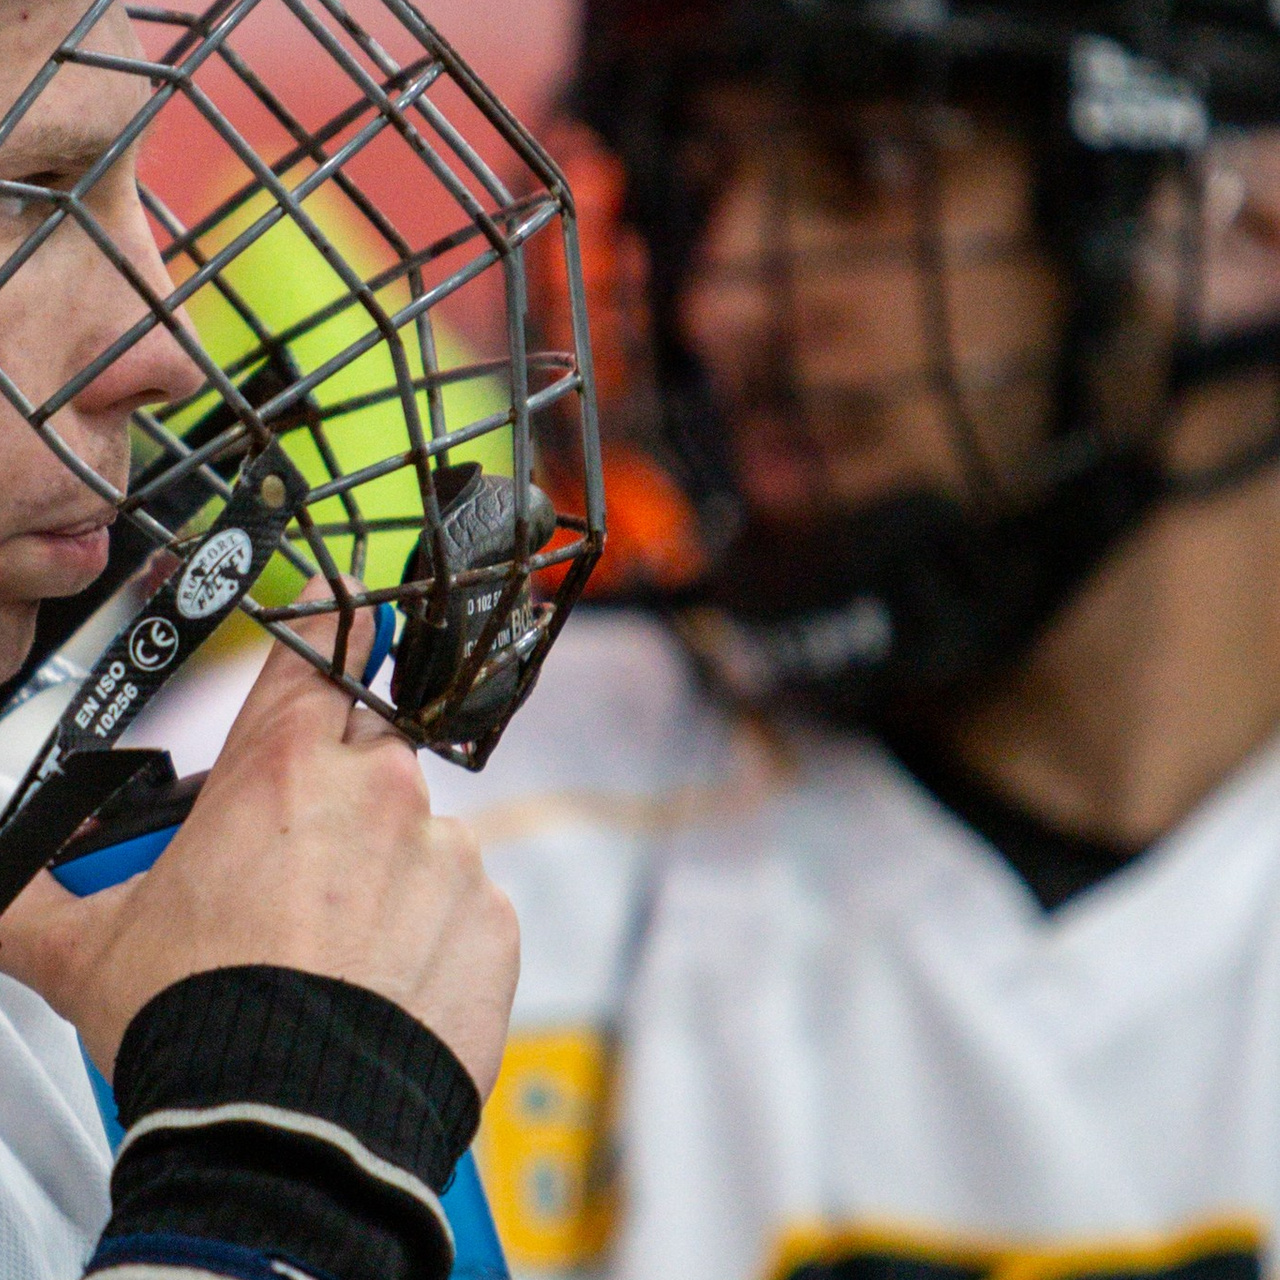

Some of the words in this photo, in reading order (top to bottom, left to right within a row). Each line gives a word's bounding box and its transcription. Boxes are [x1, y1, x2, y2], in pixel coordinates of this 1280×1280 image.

[135, 621, 176, 665] CE
[74, 695, 101, 730] EN
[94, 660, 126, 700] ISO
[94, 681, 139, 738] 10256
